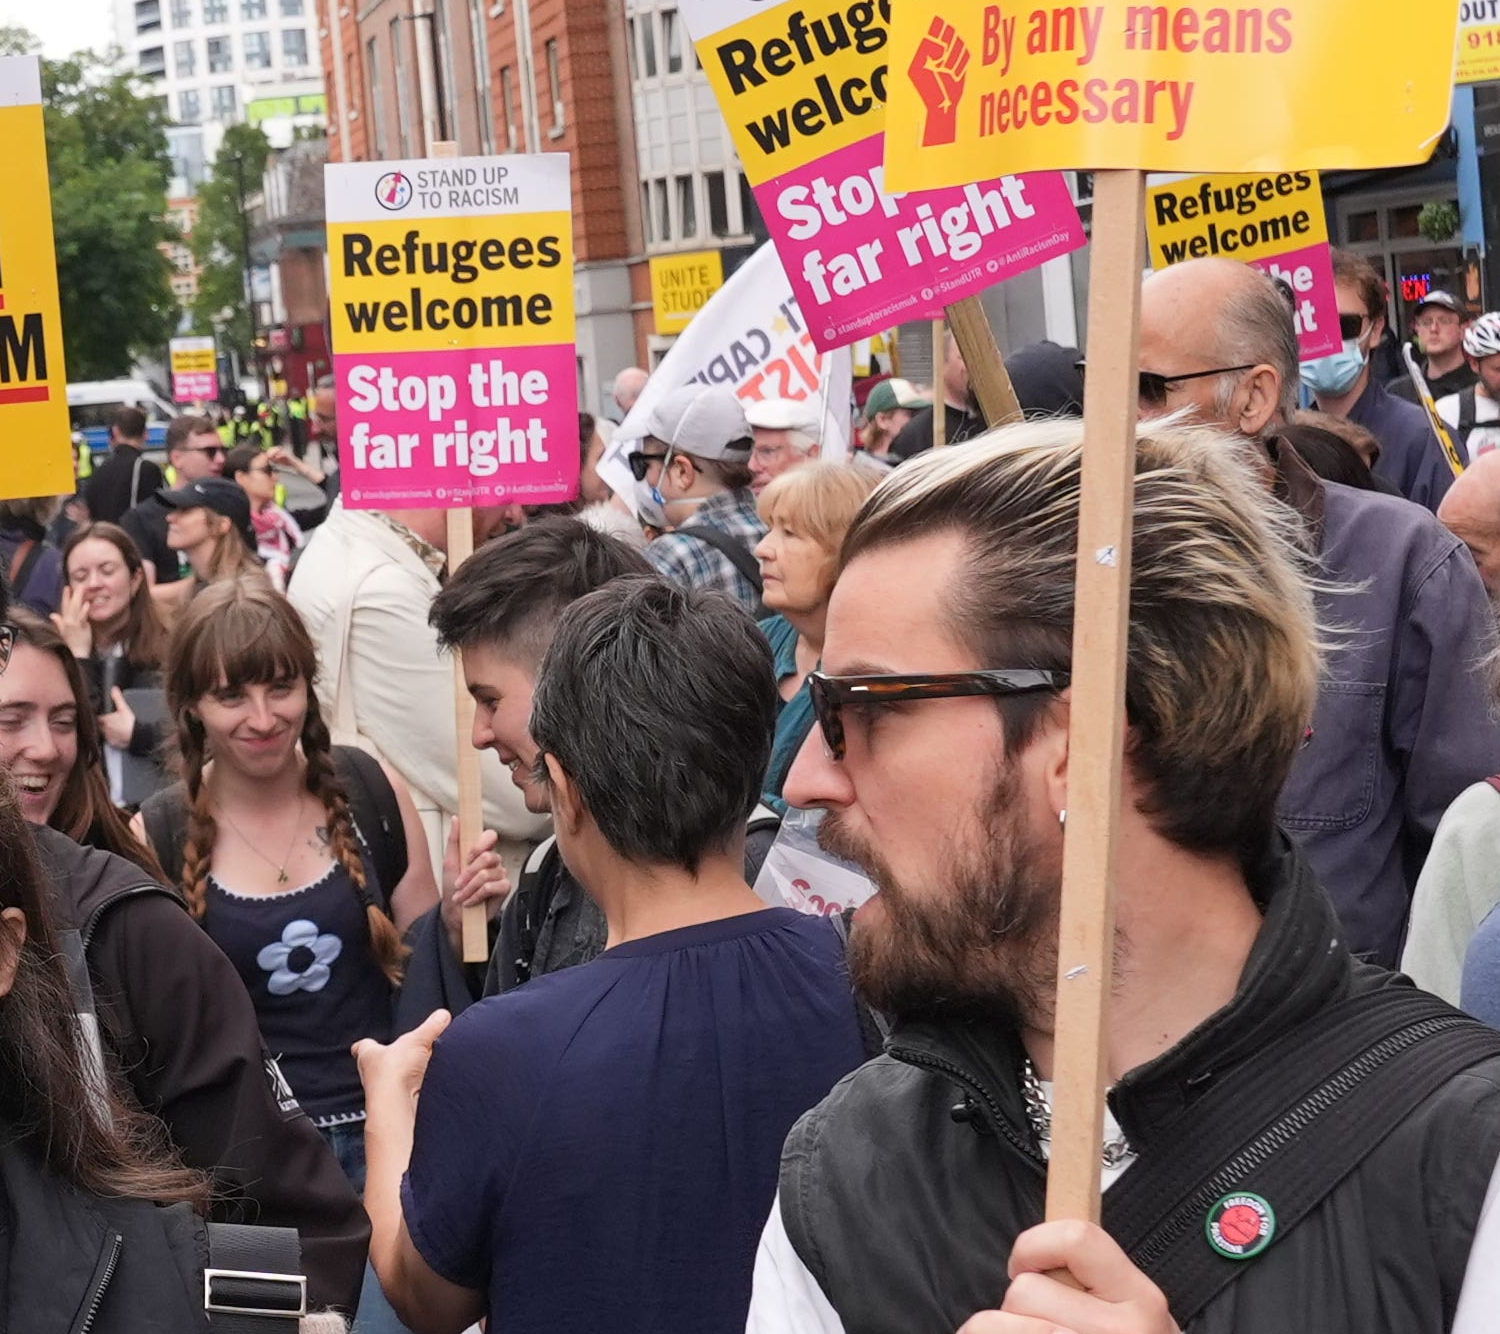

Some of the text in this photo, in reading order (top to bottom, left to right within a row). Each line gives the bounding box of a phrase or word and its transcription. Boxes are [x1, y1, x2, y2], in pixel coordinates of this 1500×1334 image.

[983, 4, 1293, 75] By any means
[979, 80, 1195, 140] necessary
[418, 167, 508, 187] STAND UP
[421, 187, 519, 209] TO RACISM
[1154, 172, 1311, 226] Refugees
[343, 230, 561, 283] Refugees
[804, 174, 1035, 305] far right
[1161, 210, 1310, 265] welcome
[660, 265, 709, 288] UNITE
[345, 288, 552, 333] welcome
[348, 359, 549, 422] Stop the
[350, 417, 549, 476] far right
